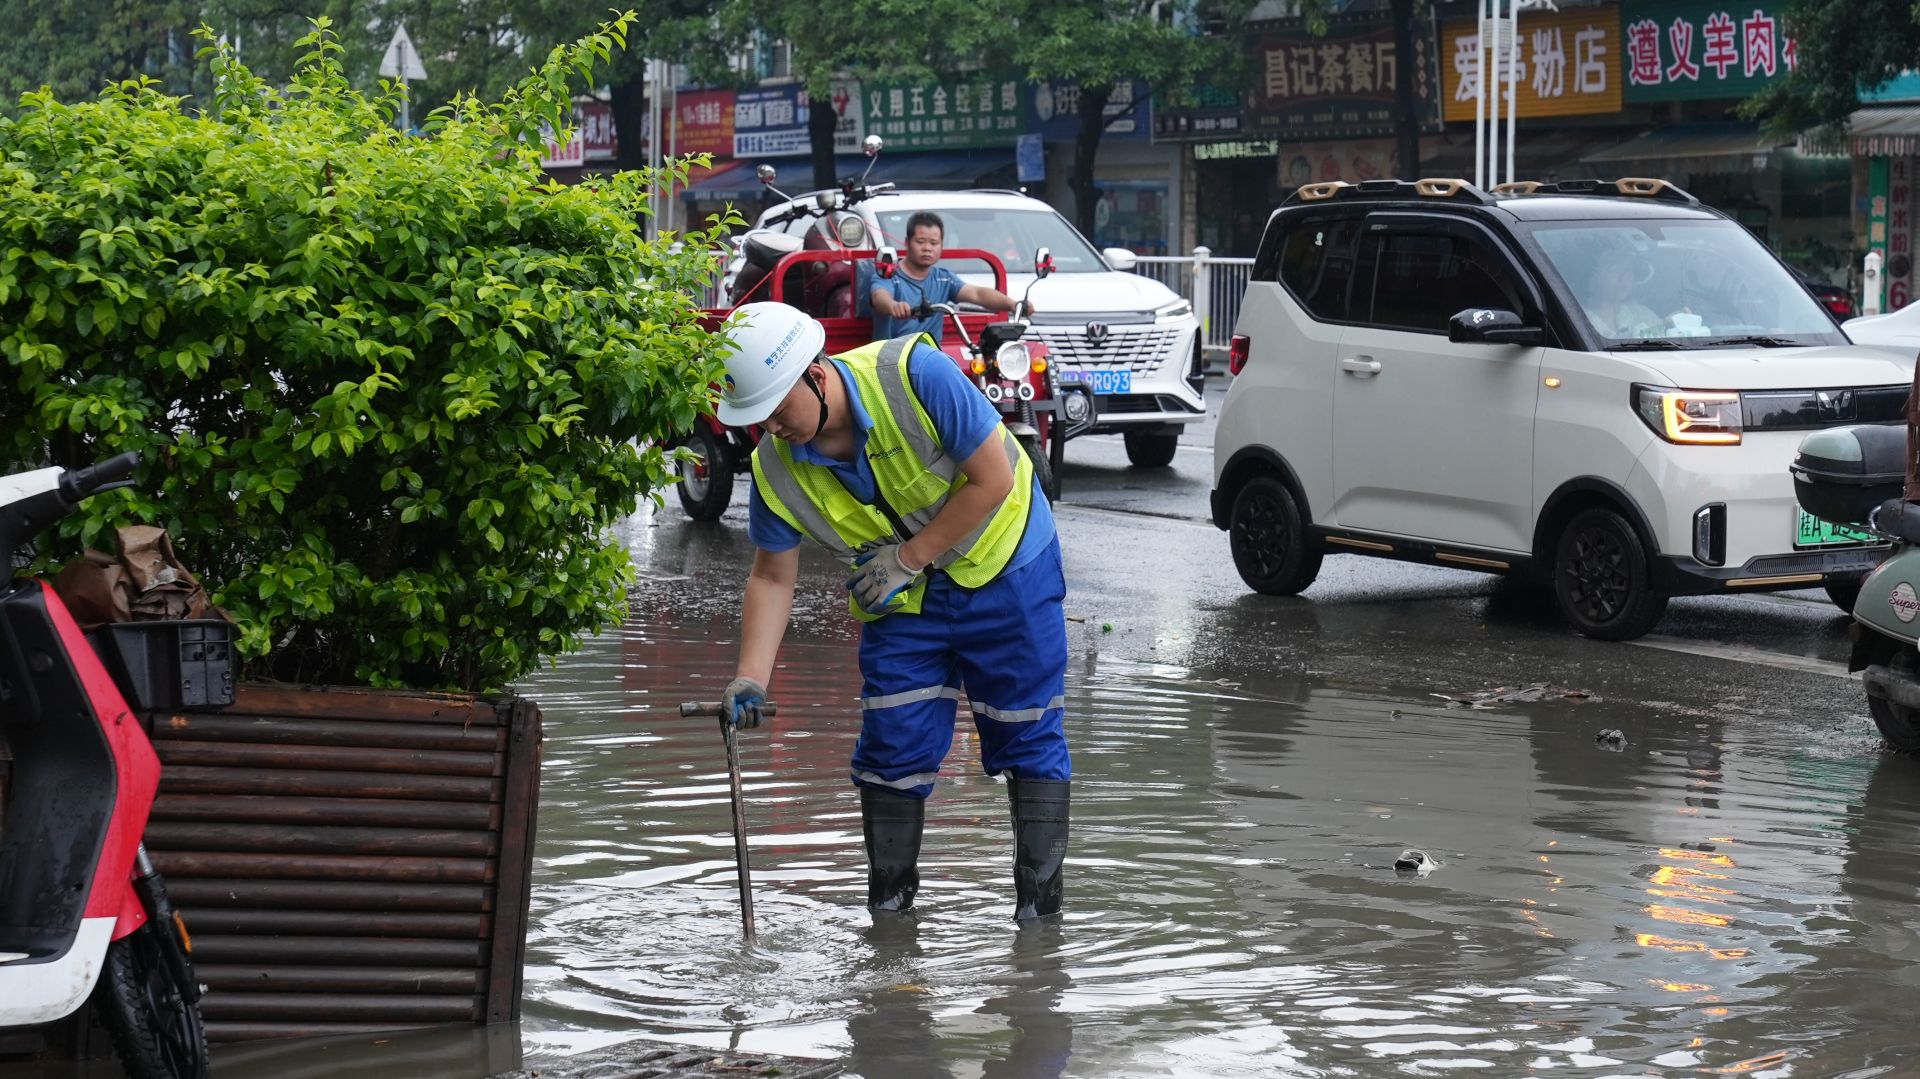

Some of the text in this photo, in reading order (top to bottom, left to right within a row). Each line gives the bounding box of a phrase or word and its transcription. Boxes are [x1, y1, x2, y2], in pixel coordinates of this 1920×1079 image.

[1265, 42, 1396, 98] 昌记茶餐厅
